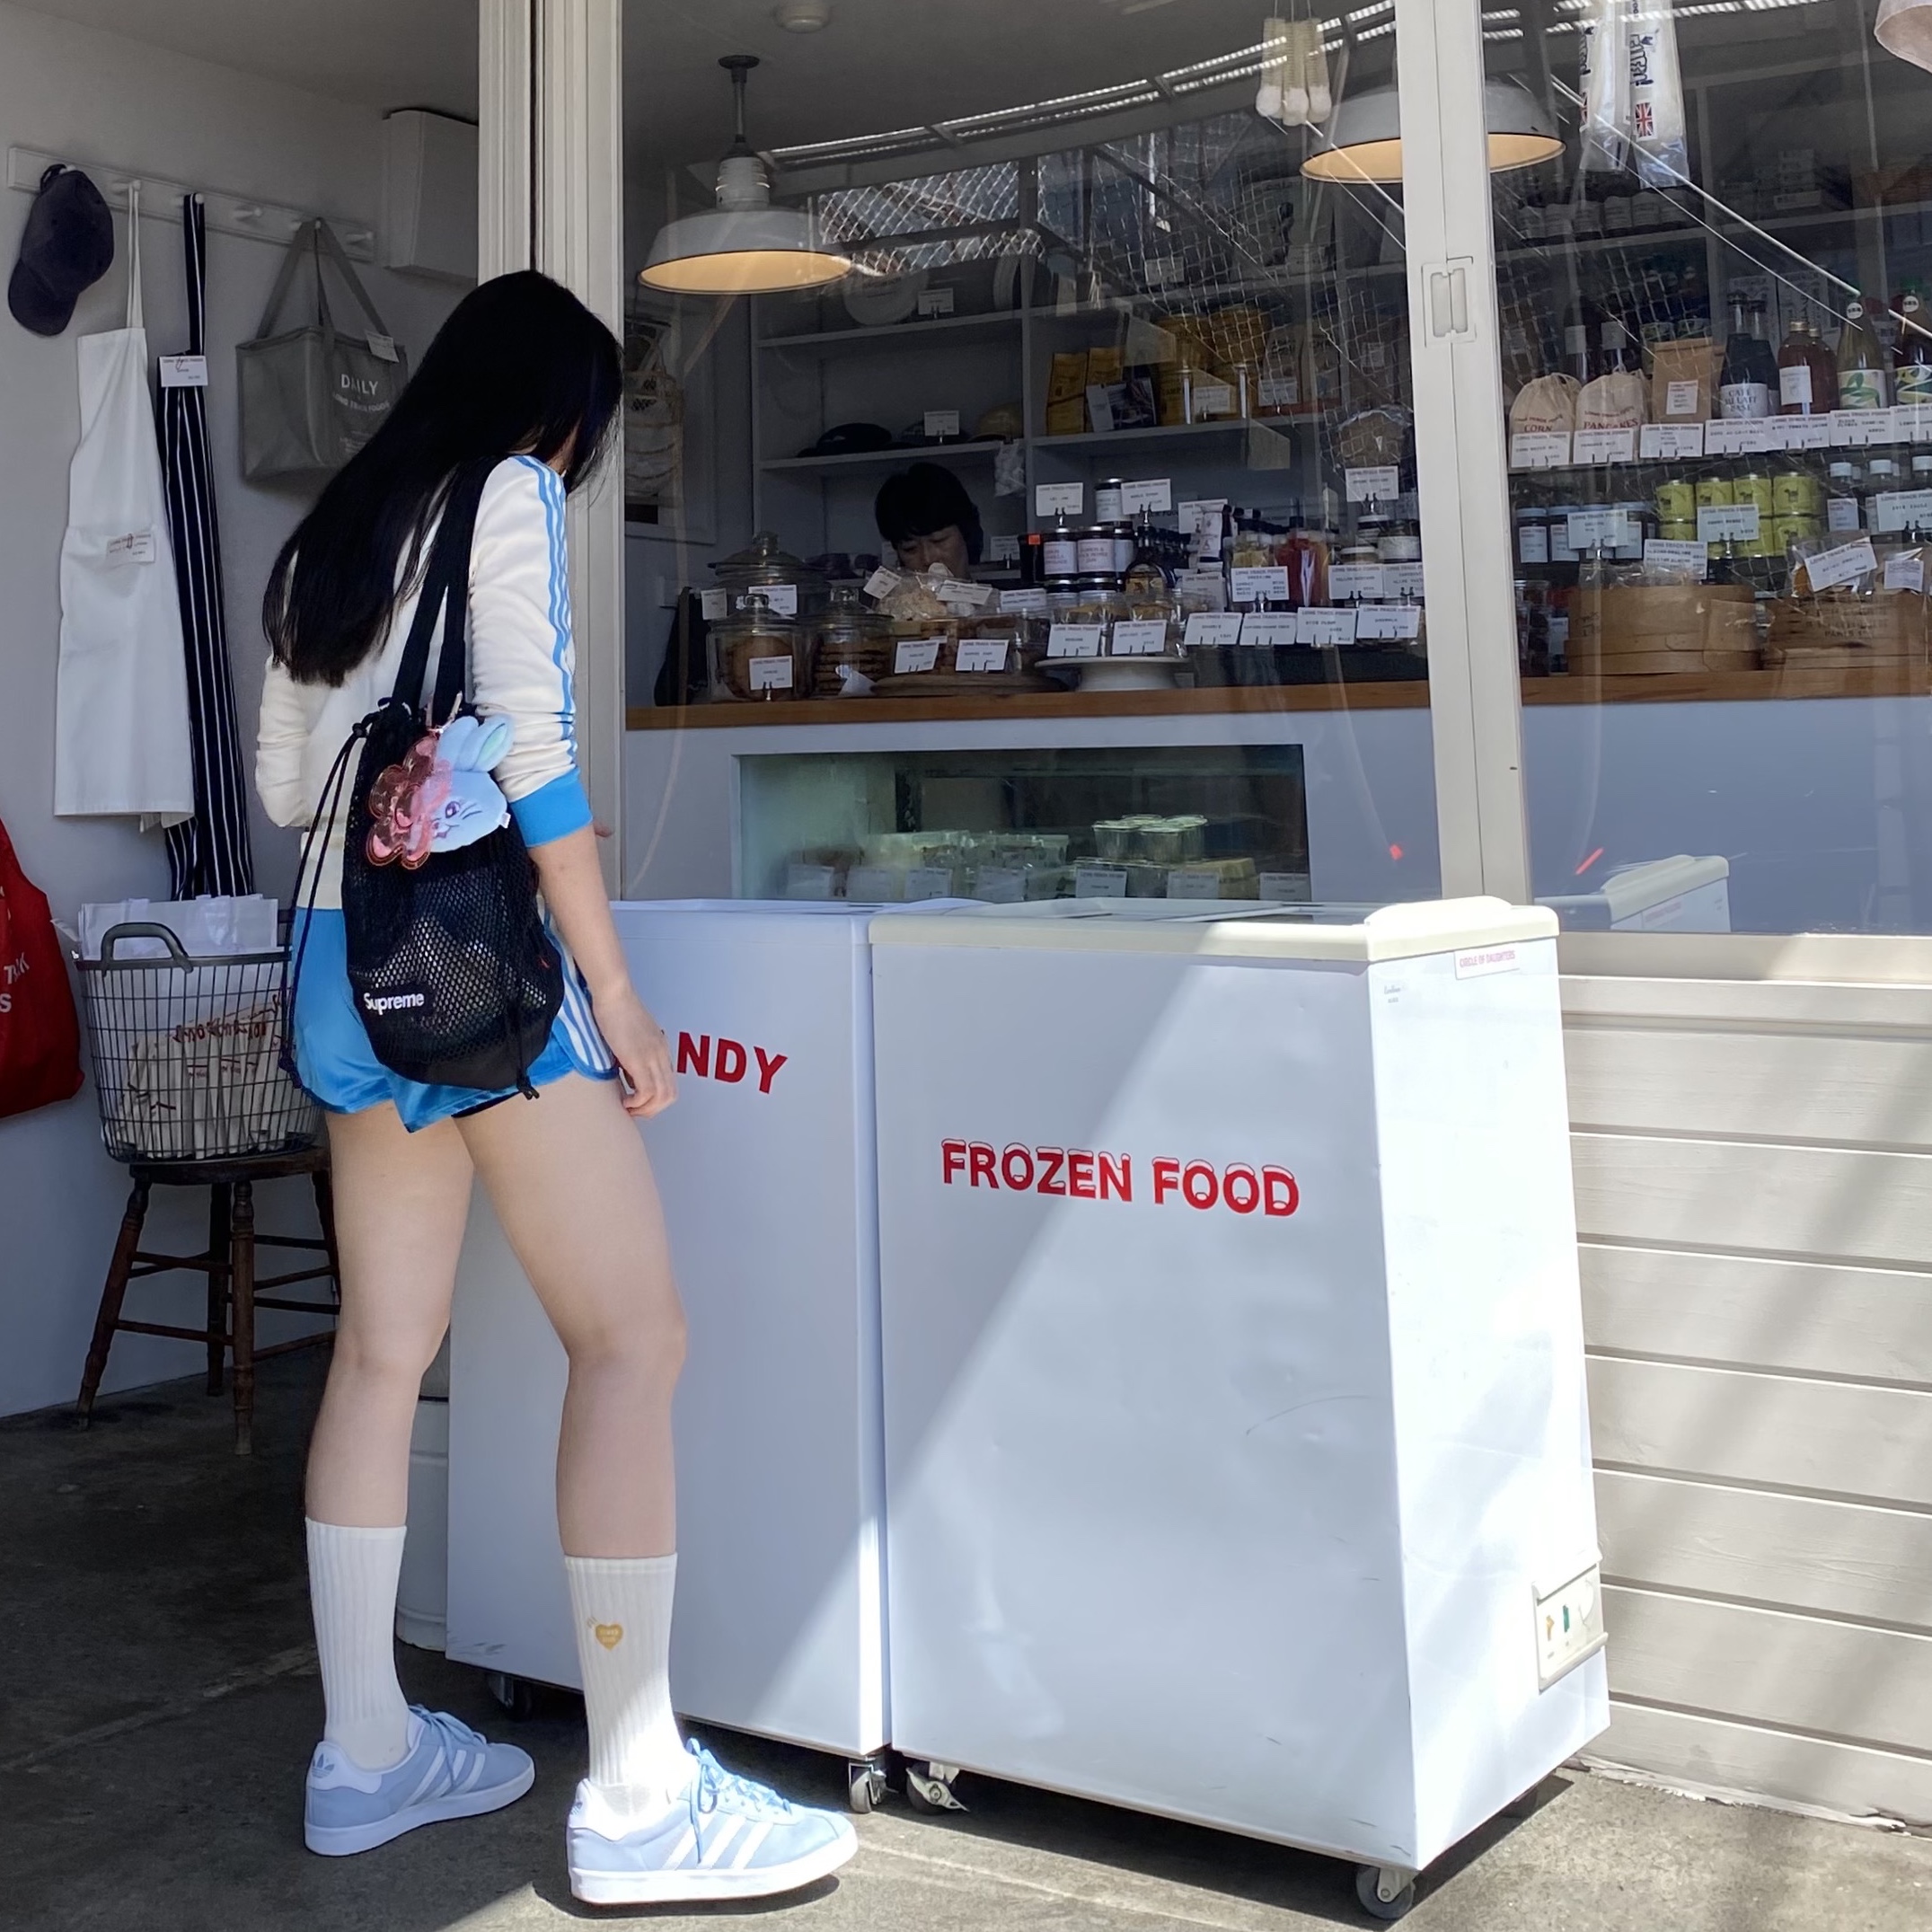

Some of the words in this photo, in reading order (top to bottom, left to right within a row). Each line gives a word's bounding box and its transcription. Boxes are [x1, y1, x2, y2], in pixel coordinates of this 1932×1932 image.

[341, 373, 378, 395] DAILY
[1524, 424, 1553, 433] CORN
[1584, 418, 1640, 430] PANCAKES
[1478, 954, 1486, 965] OF
[363, 992, 425, 1016] Supreme
[676, 1031, 789, 1095] NDY
[940, 1137, 1134, 1203] FROZEN
[1152, 1155, 1301, 1218] FOOD
